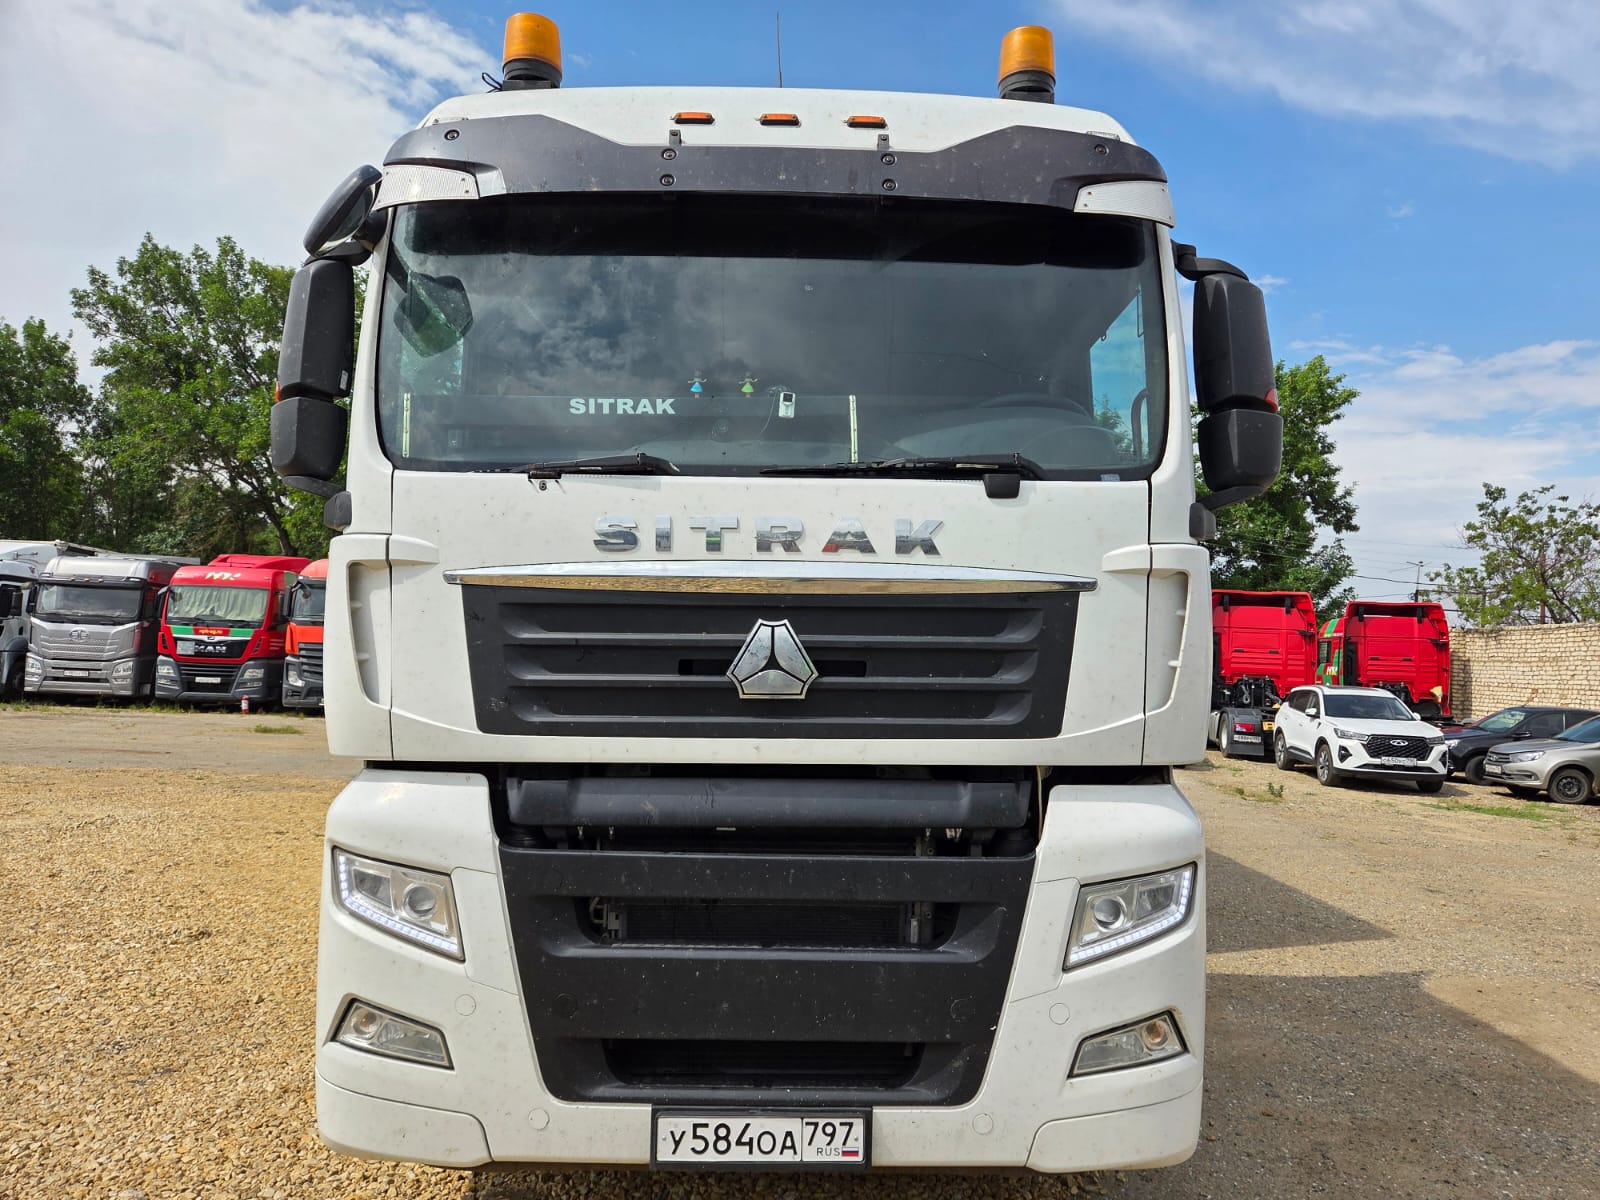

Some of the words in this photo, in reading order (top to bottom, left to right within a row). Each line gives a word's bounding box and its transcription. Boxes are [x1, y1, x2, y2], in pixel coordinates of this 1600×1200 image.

[569, 398, 675, 415] SITRAK
[593, 515, 945, 556] SITRAK
[805, 1122, 854, 1146] 797
[817, 1147, 840, 1157] RUS
